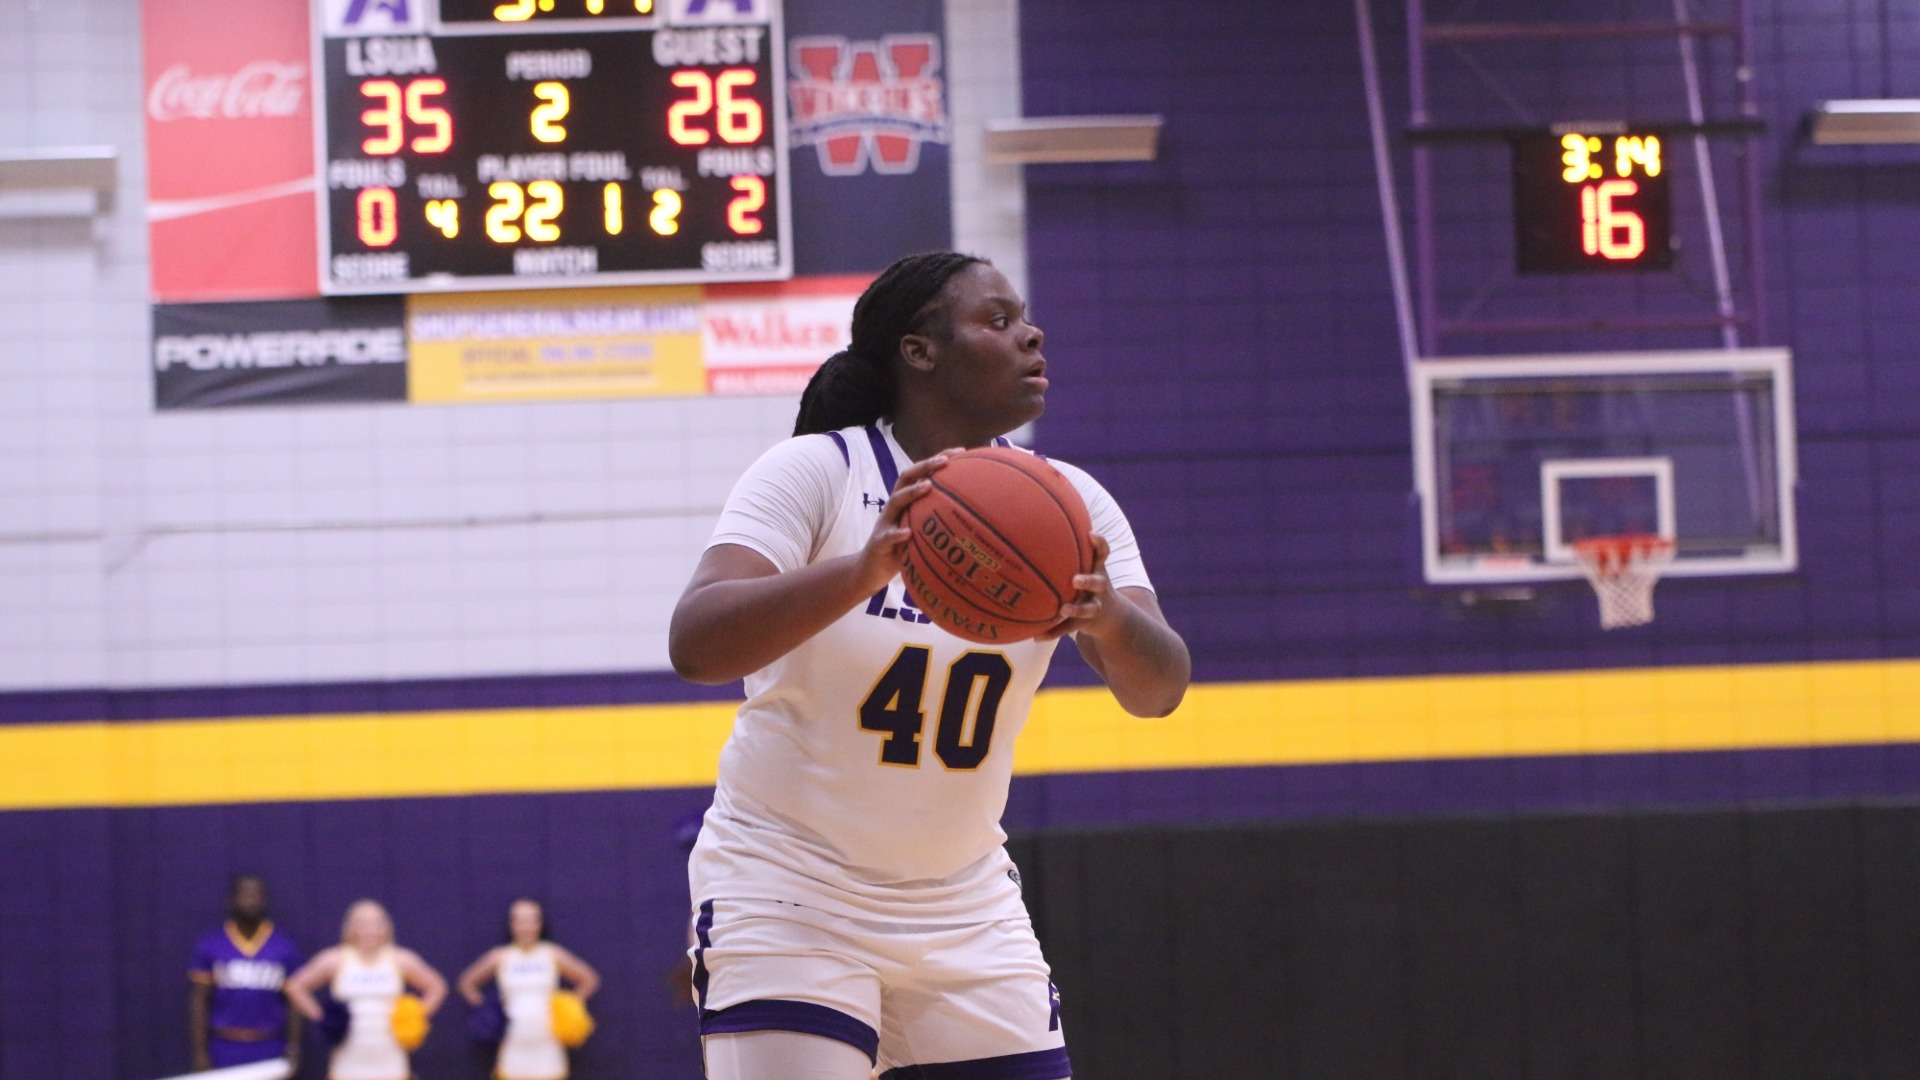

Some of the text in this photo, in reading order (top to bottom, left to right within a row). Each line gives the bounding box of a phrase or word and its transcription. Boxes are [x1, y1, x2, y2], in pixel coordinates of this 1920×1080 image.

[345, 36, 438, 76] LSUA
[506, 50, 592, 80] PERIOD
[652, 27, 765, 66] GUEST
[359, 79, 453, 156] 35
[530, 81, 571, 144] 2
[667, 69, 764, 146] 26
[329, 159, 406, 188] FOULS
[478, 151, 632, 183] PLAYER FOUL
[698, 148, 775, 177] FOULS
[1560, 133, 1661, 183] 3:14
[356, 185, 399, 248] 0
[424, 199, 459, 239] 4
[485, 180, 564, 243] 22
[603, 182, 624, 236] 1
[649, 188, 682, 236] 2
[727, 174, 766, 235] 2
[1581, 179, 1645, 260] 16
[332, 252, 411, 283] SCORE
[701, 242, 778, 270] SCORE
[155, 326, 408, 372] POWERADE
[955, 536, 1001, 572] LEGACY
[856, 642, 1015, 773] 40
